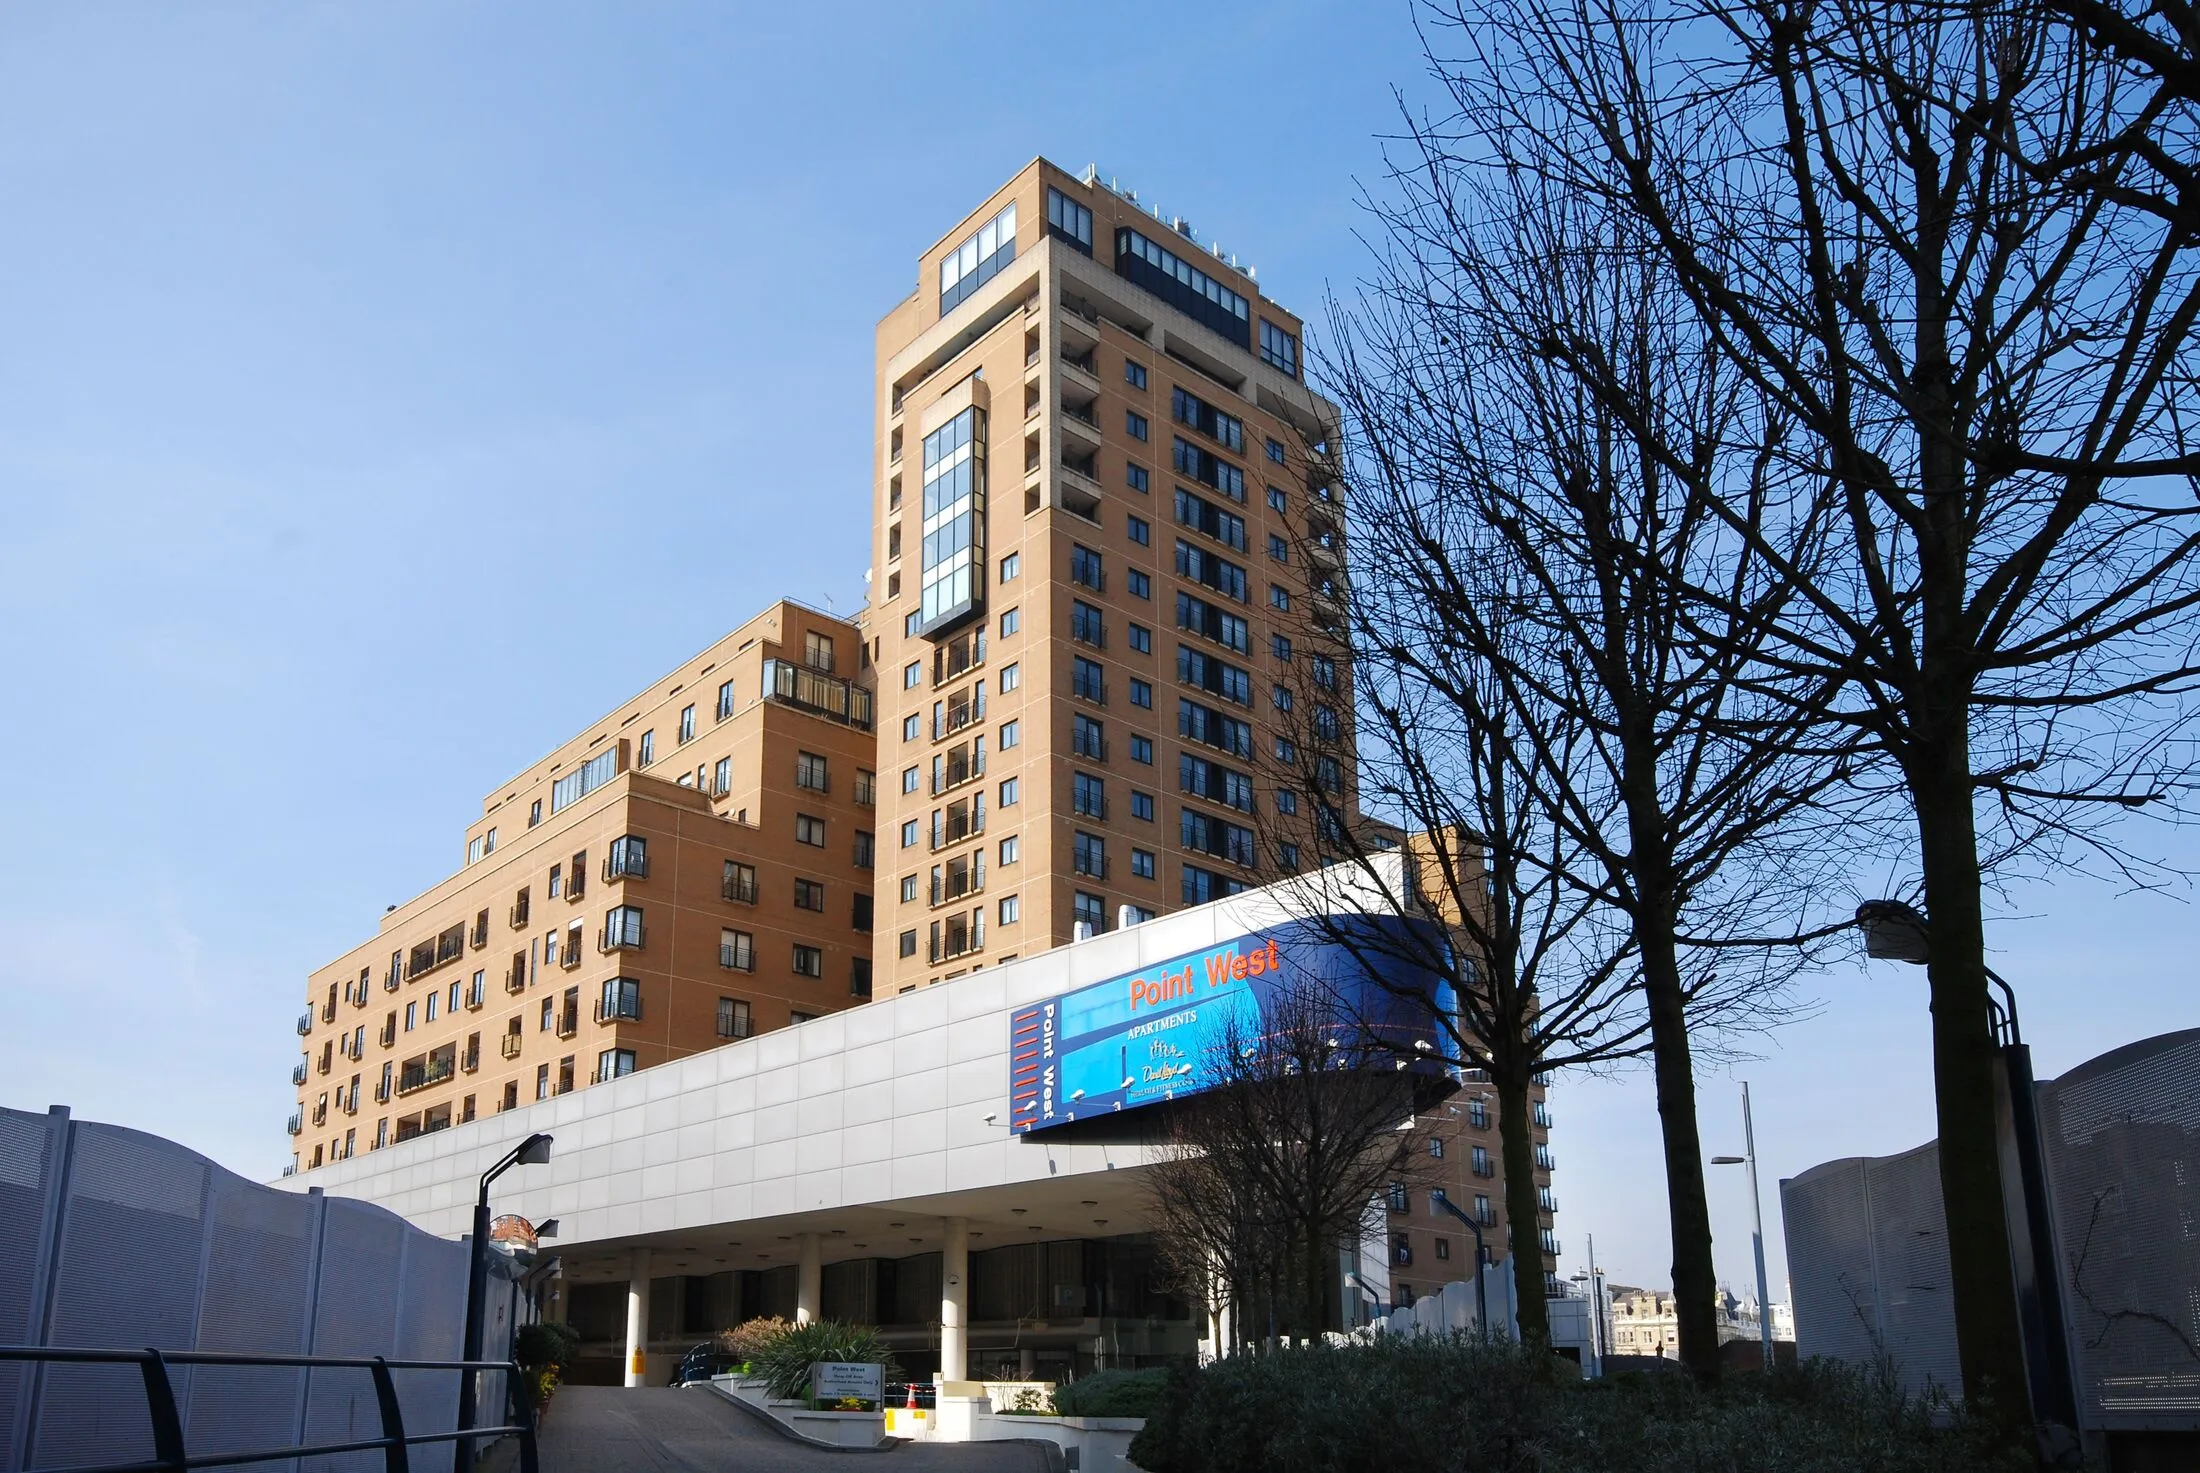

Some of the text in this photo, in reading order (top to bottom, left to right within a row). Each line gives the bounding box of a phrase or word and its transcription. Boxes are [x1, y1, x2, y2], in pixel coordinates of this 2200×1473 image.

[1130, 938, 1280, 1011] Point West
[1043, 1003, 1055, 1120] Point West
[1127, 1010, 1197, 1040] APARTMENTS
